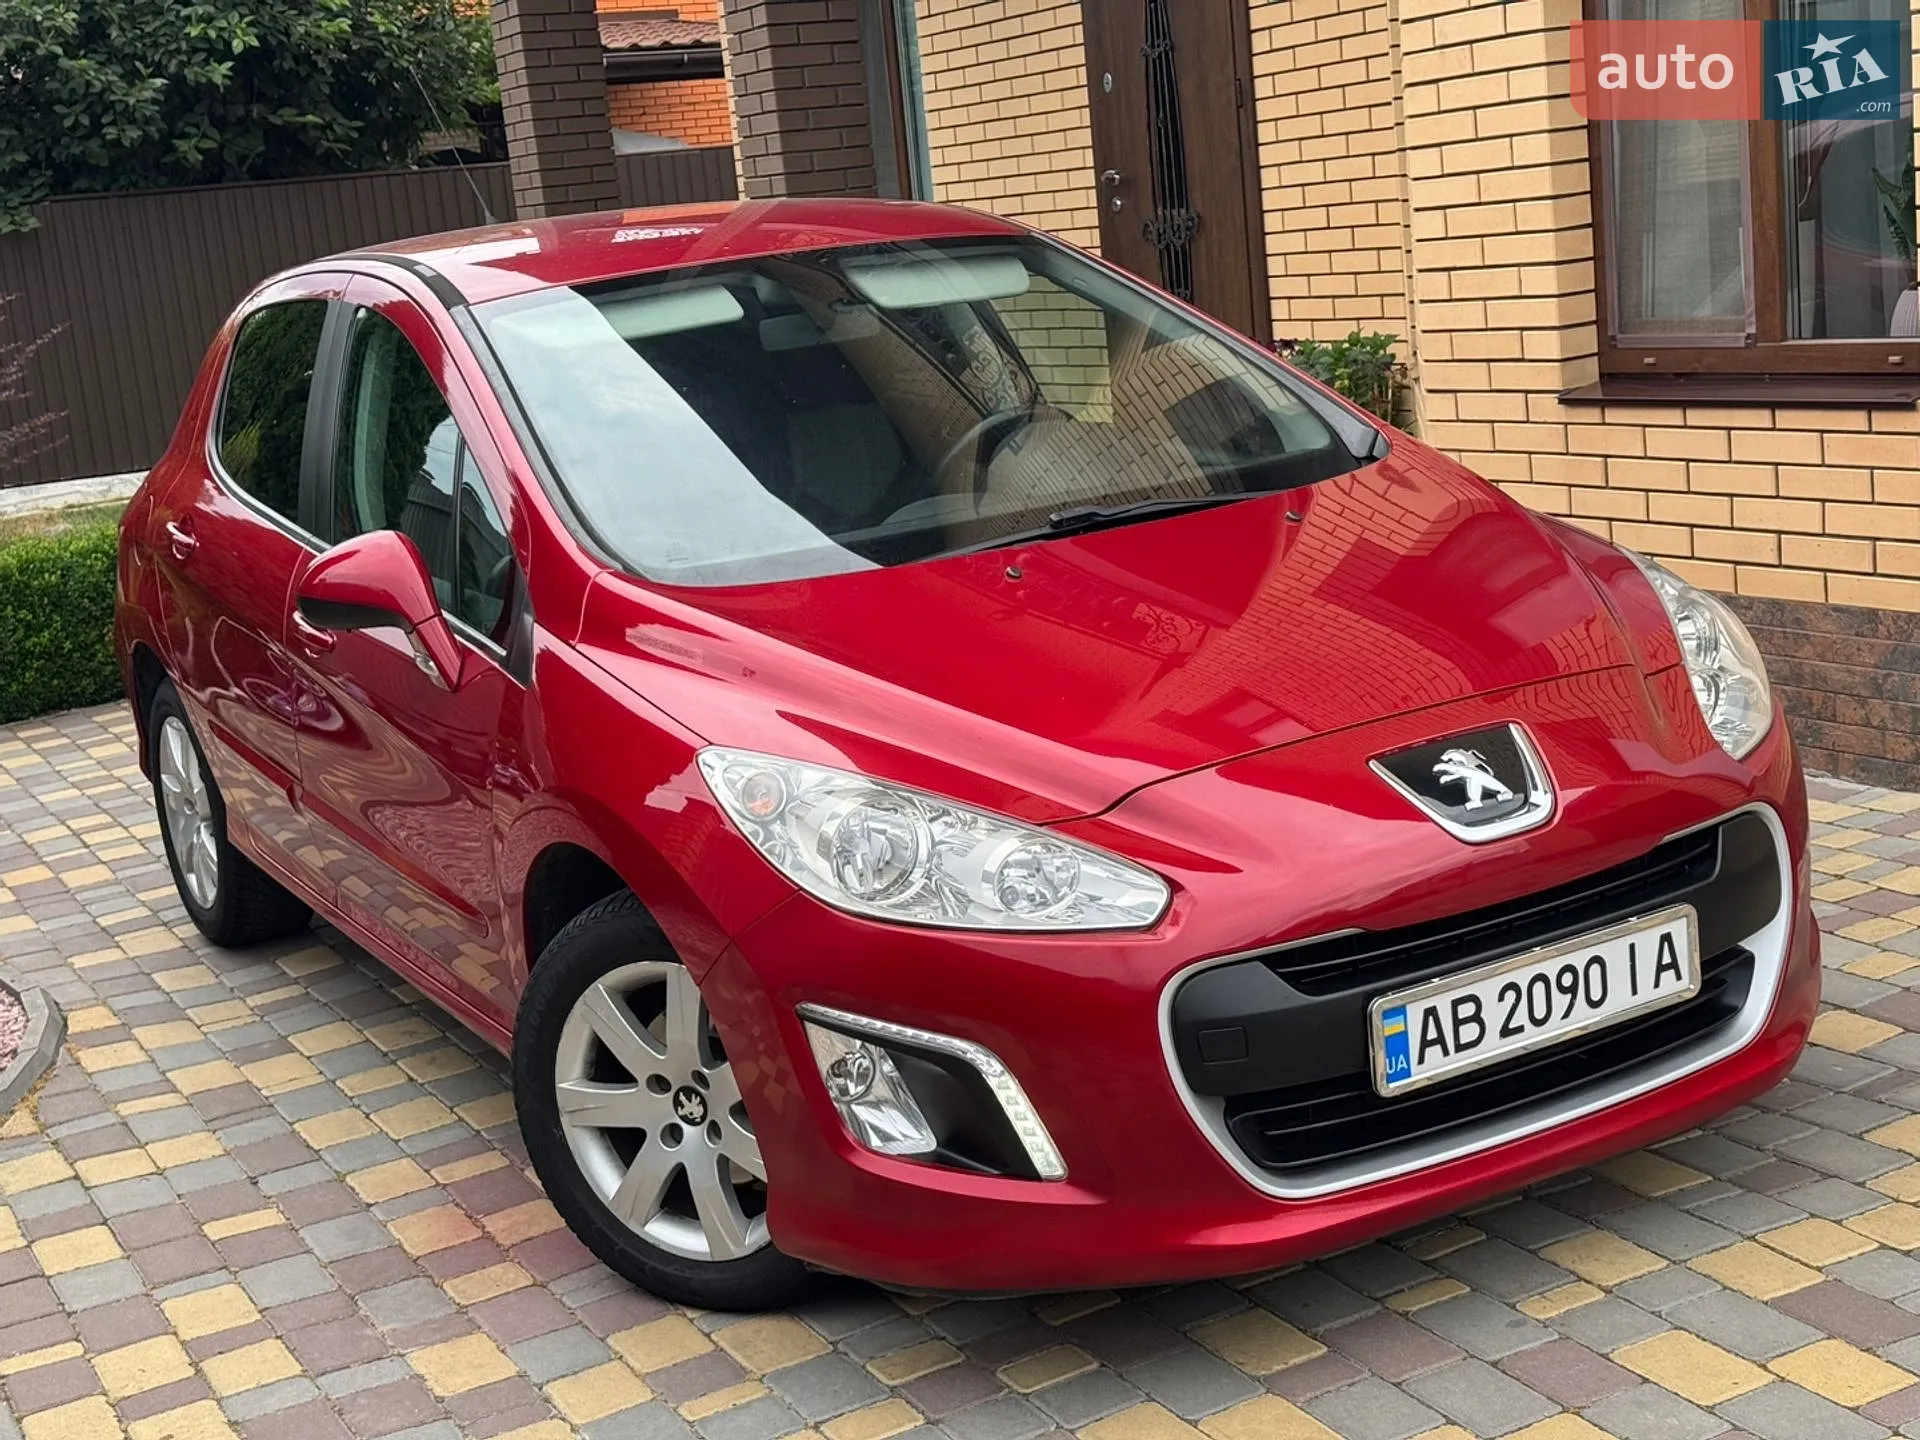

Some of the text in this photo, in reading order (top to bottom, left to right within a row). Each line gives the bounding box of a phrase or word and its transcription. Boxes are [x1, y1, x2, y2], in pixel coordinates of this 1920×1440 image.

[1416, 993, 1487, 1066] AB
[1496, 954, 1608, 1039] 2090
[1386, 1055, 1408, 1074] UA
